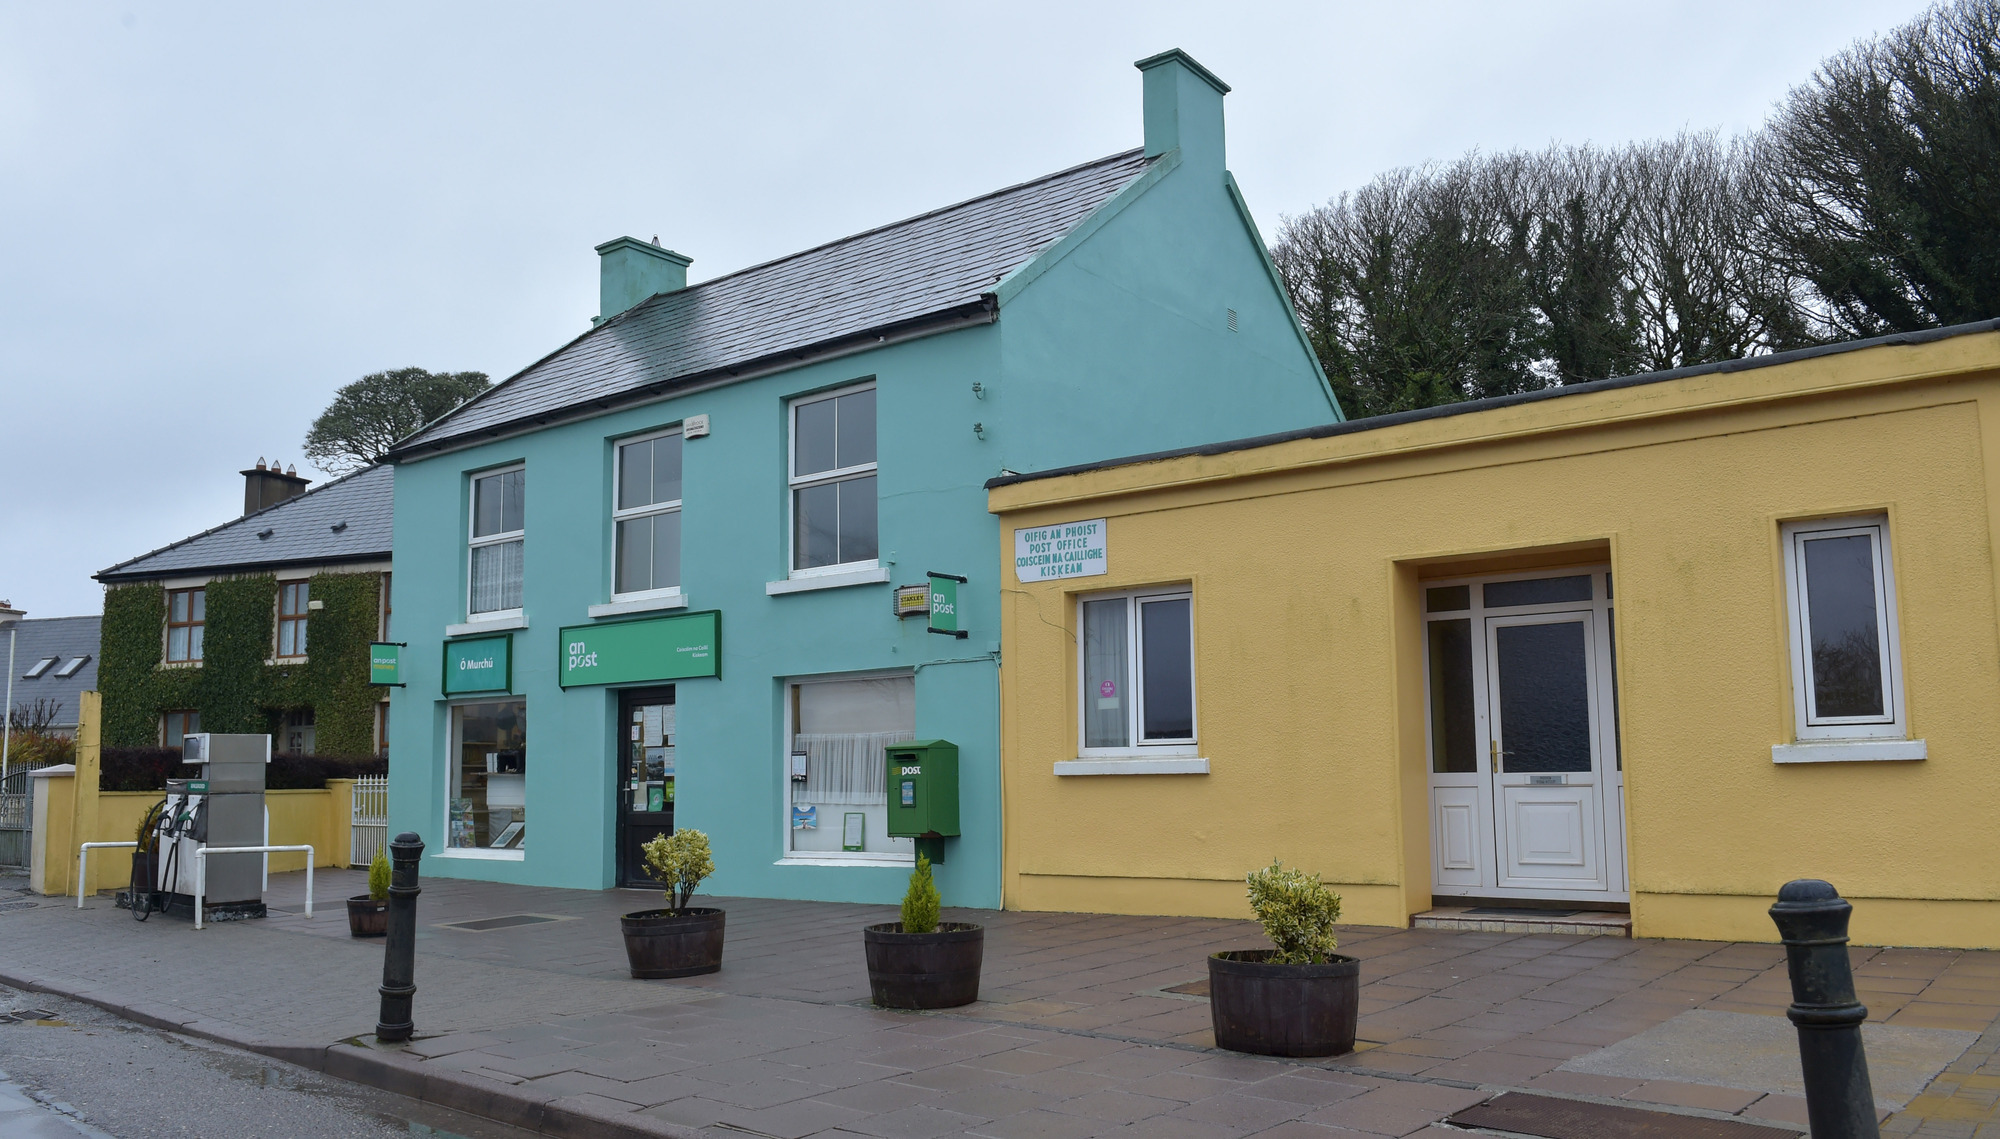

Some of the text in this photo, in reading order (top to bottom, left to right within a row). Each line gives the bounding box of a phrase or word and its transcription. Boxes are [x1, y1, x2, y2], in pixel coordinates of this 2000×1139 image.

[1024, 523, 1097, 543] OIFIG AN PHOIST
[1029, 537, 1088, 554] POST OFFICE
[1052, 552, 1063, 564] NA
[1064, 548, 1103, 562] CAILLIGHE
[1040, 562, 1082, 577] KISKEAM
[933, 592, 945, 603] an
[933, 603, 954, 615] post
[569, 641, 585, 655] an
[460, 657, 494, 670] Ó Murchú
[568, 651, 598, 671] post
[901, 766, 921, 776] post
